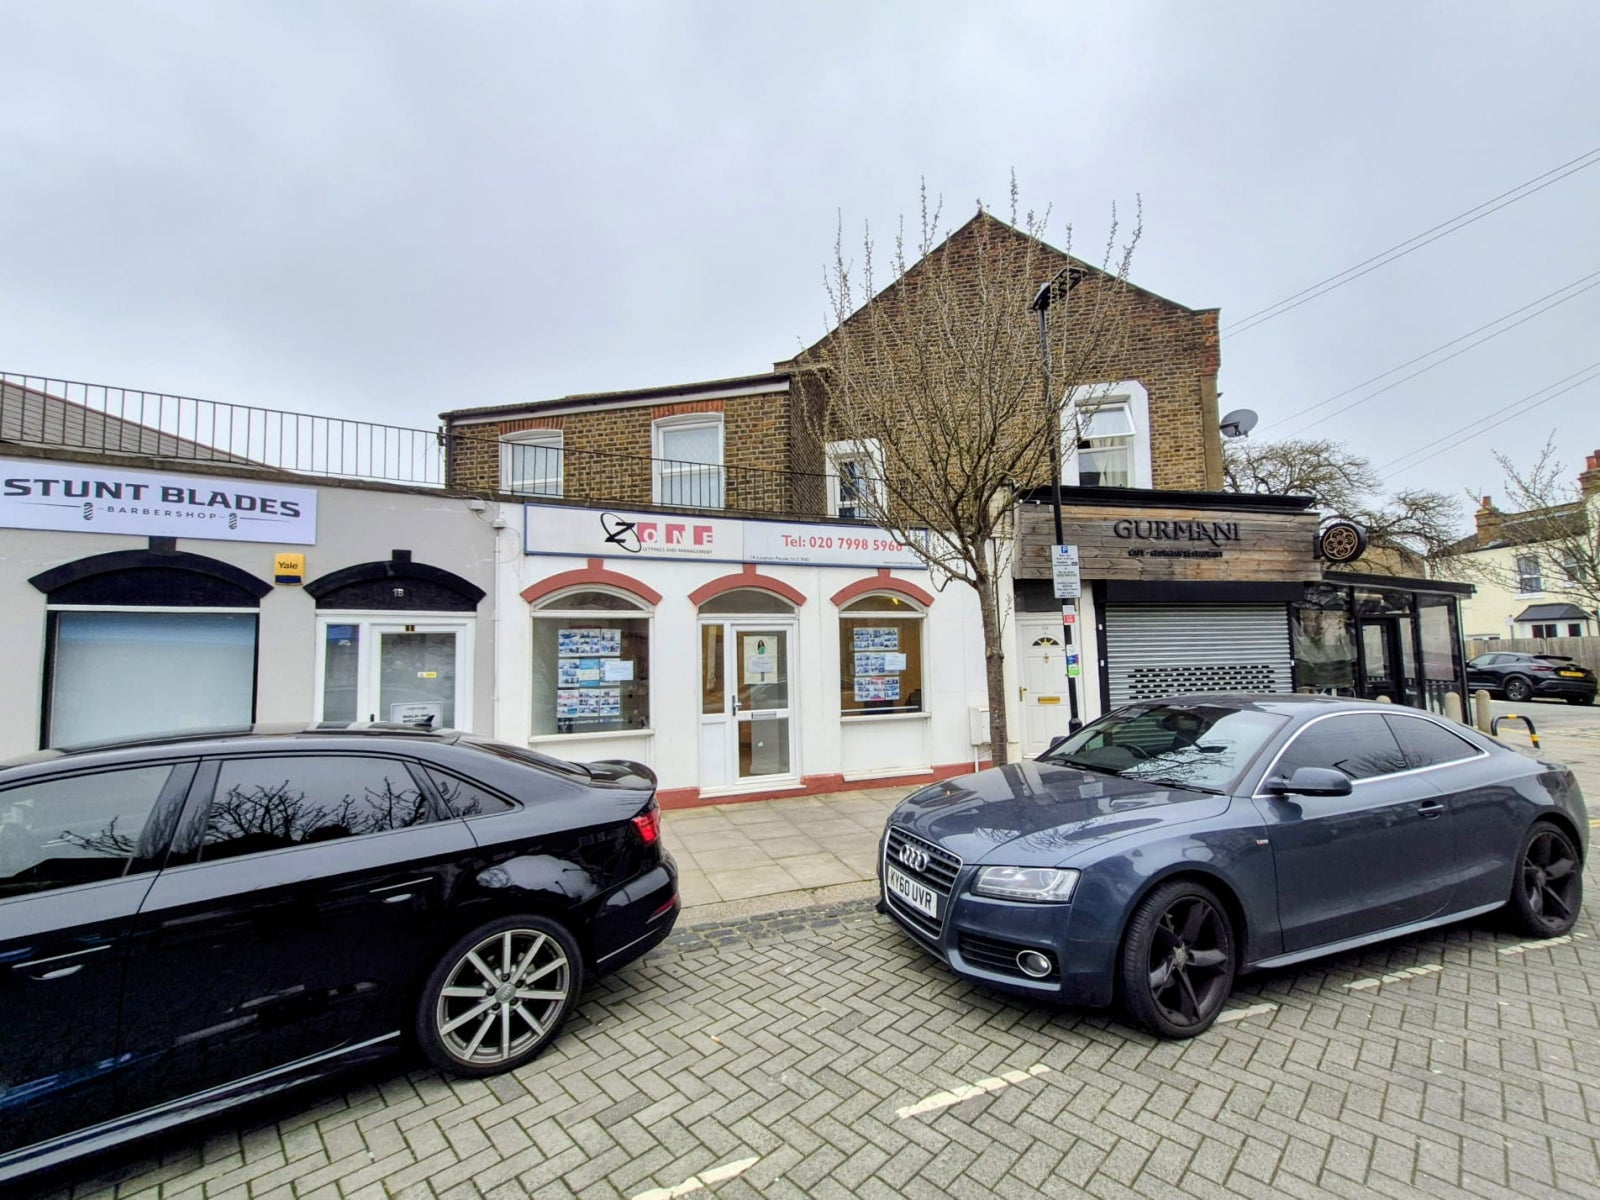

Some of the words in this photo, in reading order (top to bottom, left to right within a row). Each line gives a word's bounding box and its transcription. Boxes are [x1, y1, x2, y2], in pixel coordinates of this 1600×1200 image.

[4, 478, 149, 501] STUNT
[161, 485, 301, 518] BLADES
[107, 505, 217, 520] BARBERSHOP
[782, 535, 806, 548] Tel:
[809, 536, 833, 549] 020
[838, 537, 869, 550] 7998
[1113, 519, 1241, 547] GURMANI
[278, 561, 299, 570] Yale
[890, 869, 910, 897] KY60
[912, 884, 932, 911] UVR
